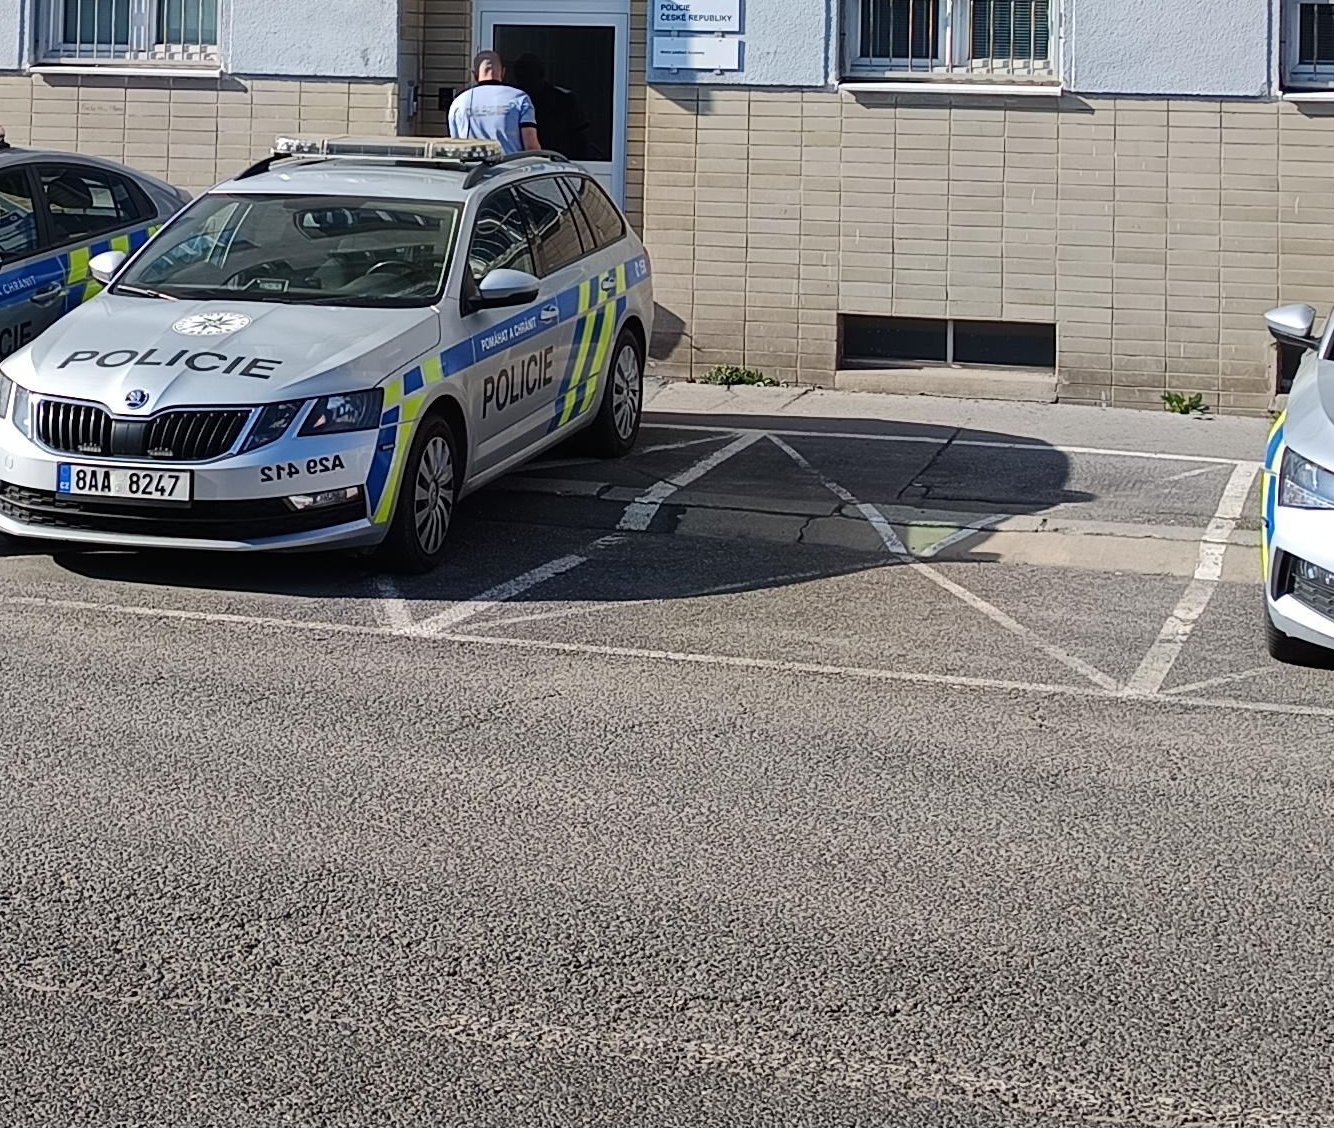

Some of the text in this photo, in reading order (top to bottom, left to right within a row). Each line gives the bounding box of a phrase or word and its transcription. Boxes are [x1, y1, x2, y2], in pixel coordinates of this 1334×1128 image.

[660, 4, 691, 12] POLICIE
[660, 13, 732, 22] ČESKÉ REPUBLIKY
[2, 275, 37, 295] CHRÁNIT
[56, 348, 284, 380] POLICIE
[482, 345, 554, 419] POLICIE
[75, 469, 180, 497] 8AA 8247
